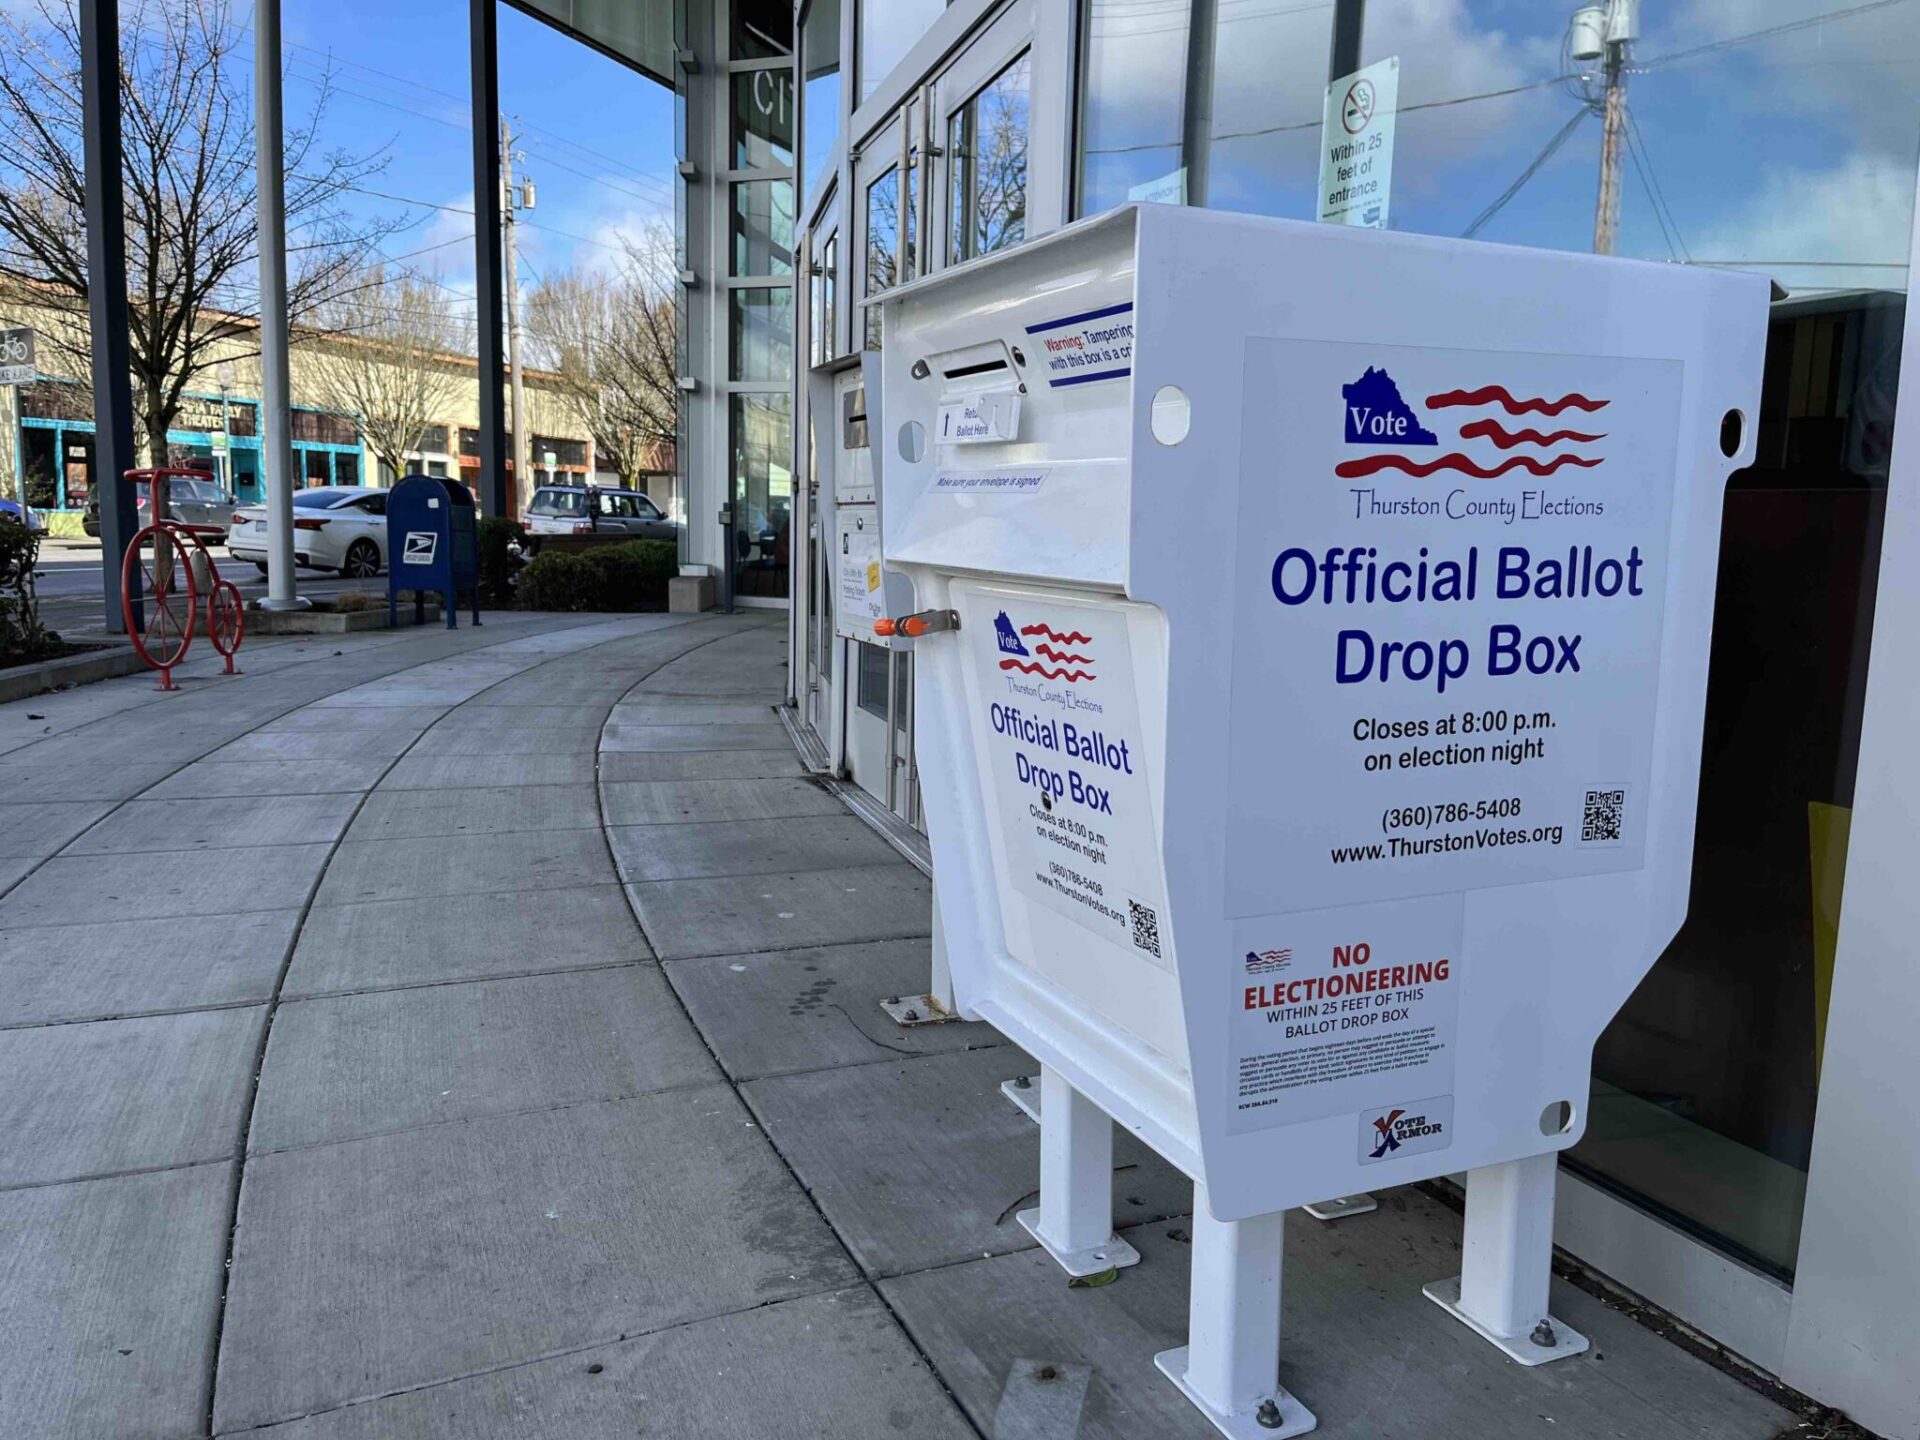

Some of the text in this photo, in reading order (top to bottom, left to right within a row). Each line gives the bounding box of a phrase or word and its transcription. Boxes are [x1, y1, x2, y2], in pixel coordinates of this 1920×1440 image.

[754, 70, 792, 125] CI
[1331, 132, 1382, 163] Within 25
[1337, 156, 1372, 182] feet of
[1329, 180, 1377, 204] entrance
[1044, 336, 1085, 352] Warning:
[1048, 356, 1068, 370] with
[1067, 353, 1085, 368] this
[1083, 352, 1104, 365] box
[1101, 348, 1112, 361] is
[1112, 348, 1120, 360] a
[956, 425, 988, 436] Ballot Here
[964, 408, 978, 419] Retu
[1350, 407, 1407, 436] Vote
[937, 478, 952, 486] Make
[963, 479, 980, 488] your
[980, 478, 1009, 488] envelope
[1016, 475, 1042, 488] signed
[1350, 488, 1604, 525] Thurston County Elections
[1271, 545, 1643, 605] Official Ballot
[998, 631, 1018, 650] Vote
[1336, 624, 1582, 694] Drop Box
[1006, 676, 1103, 714] Thurston County Elections
[991, 702, 1133, 775] Official Ballot
[1353, 710, 1556, 741] Closes at 8:00 p.m.
[1364, 738, 1544, 771] on election night
[1016, 752, 1112, 816] Drop Box
[1030, 804, 1108, 847] Closes at 8:00 p.m.
[1382, 798, 1521, 833] (360)786-5408
[1037, 825, 1107, 865] on election night
[1331, 826, 1563, 864] www.ThurstonVotes.org
[1049, 861, 1103, 896] (360)786-5408
[1035, 872, 1125, 927] www.ThurstonVotes.org
[1333, 942, 1370, 968] NO
[1245, 959, 1449, 1010] ELECTIONEERING
[1267, 988, 1424, 1023] WITHIN 25 FEET OF THIS
[1286, 1008, 1409, 1039] BALLOT DROP BOX
[1368, 1123, 1442, 1158] ARMOR
[1373, 1110, 1425, 1140] VOTE
